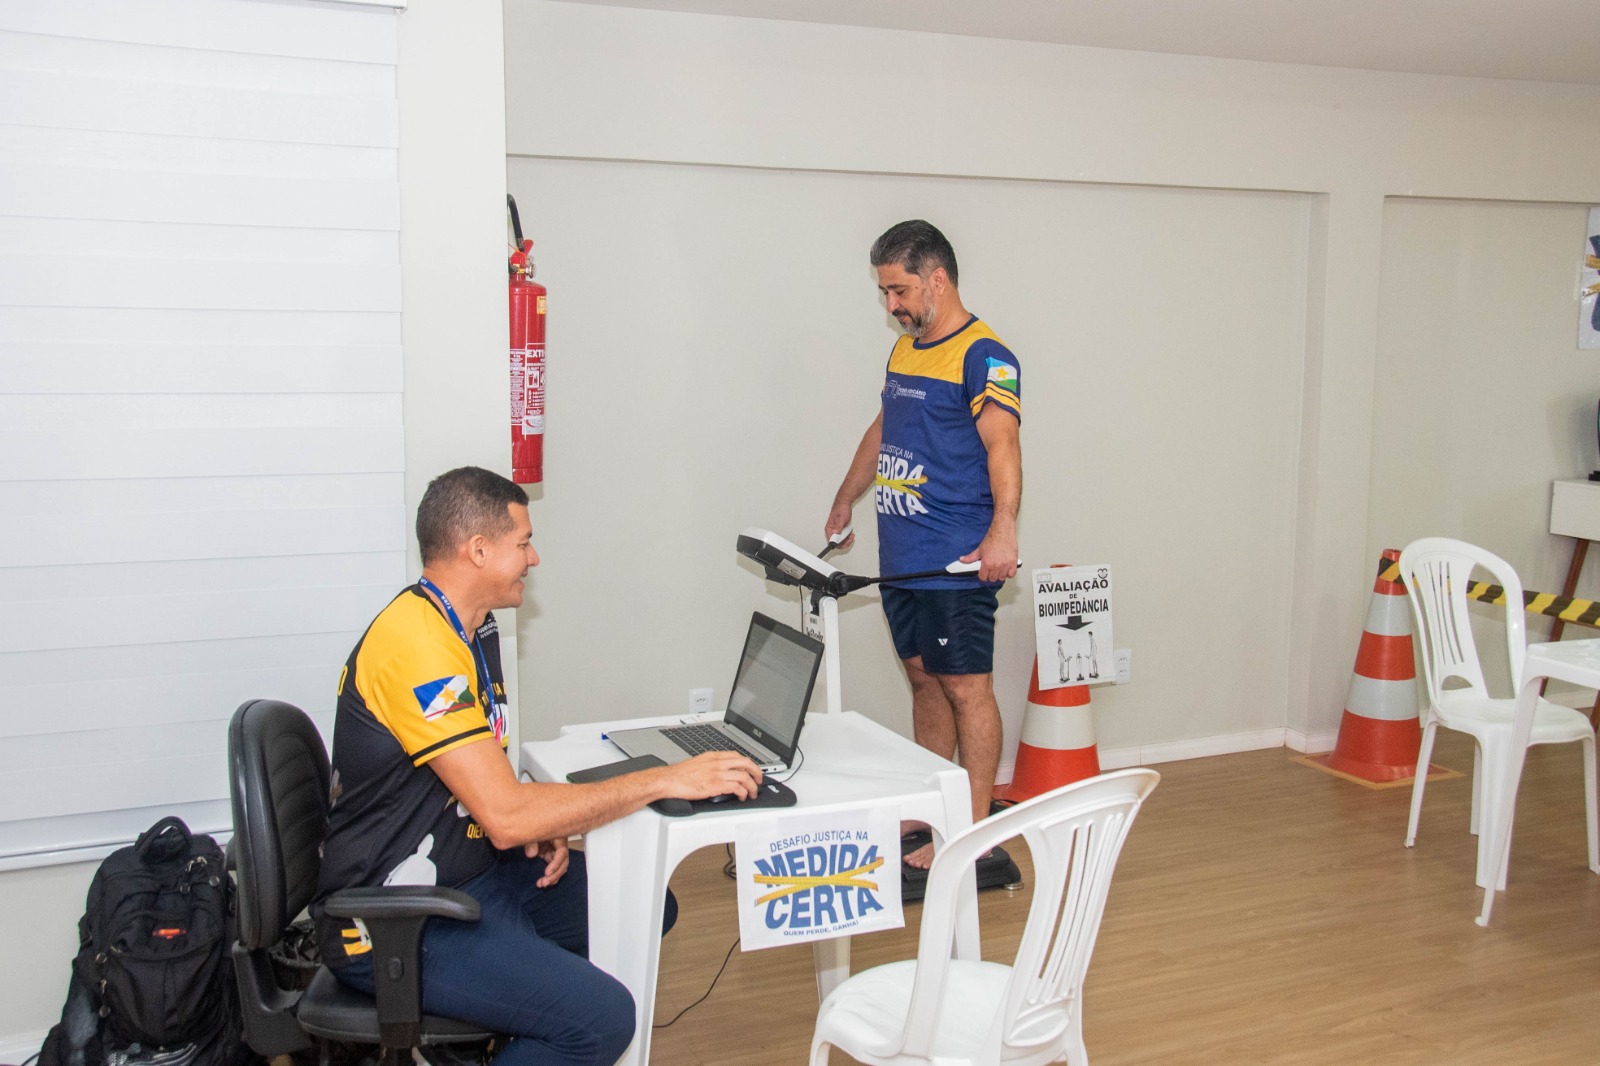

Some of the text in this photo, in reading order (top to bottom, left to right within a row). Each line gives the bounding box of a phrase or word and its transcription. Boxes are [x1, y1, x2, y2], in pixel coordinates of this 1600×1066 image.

[904, 450, 913, 460] NA
[877, 453, 924, 487] EDIDA
[875, 485, 929, 516] ERTA
[1038, 578, 1109, 593] AVALIAÇÃO
[1038, 597, 1109, 617] BIOIMPEDÂNCIA
[769, 830, 868, 852] DESAFIO JUSTIÇA NA
[753, 843, 879, 888] MEDIDA
[764, 884, 884, 930] CERTA
[783, 920, 859, 937] QUEM PERDE, GANHA!
